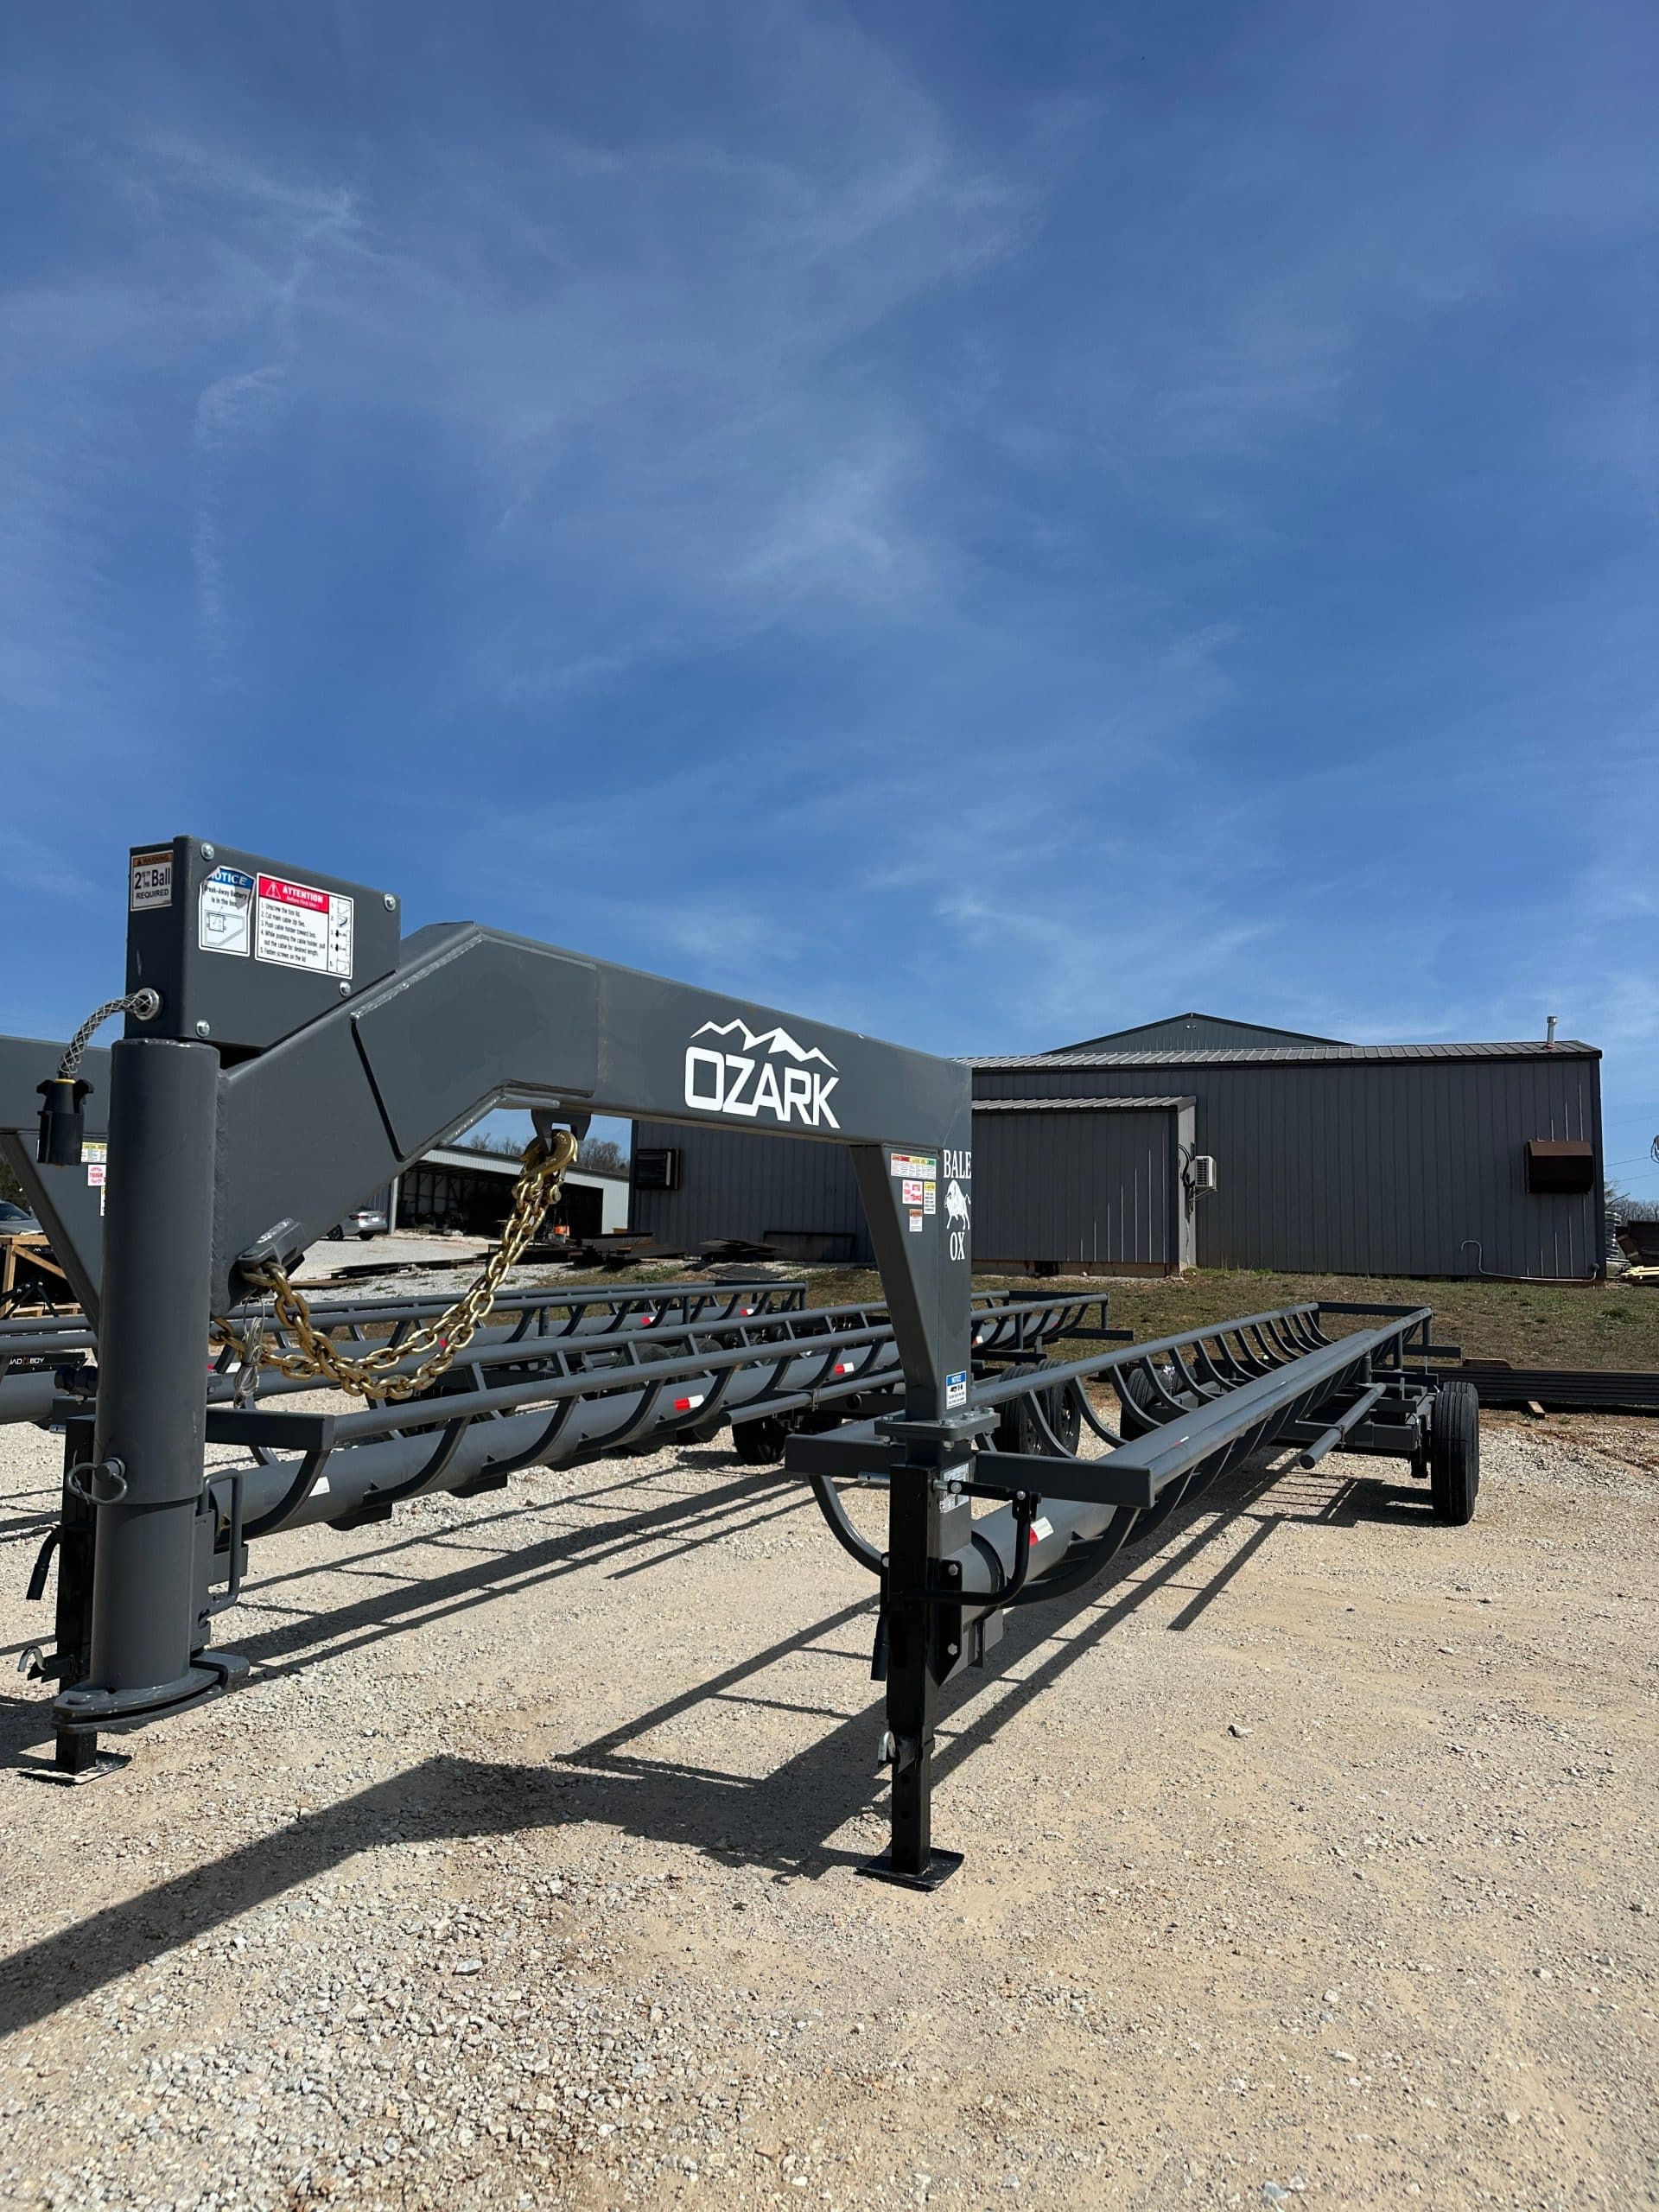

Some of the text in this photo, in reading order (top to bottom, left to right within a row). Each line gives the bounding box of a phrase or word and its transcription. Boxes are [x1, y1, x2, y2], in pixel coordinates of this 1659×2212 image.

[152, 868, 170, 887] Ball
[136, 889, 168, 899] REQUIRED
[283, 886, 323, 903] ATTENTION
[685, 1046, 841, 1128] OZARK
[944, 1150, 971, 1179] BALE
[950, 1232, 965, 1261] OX
